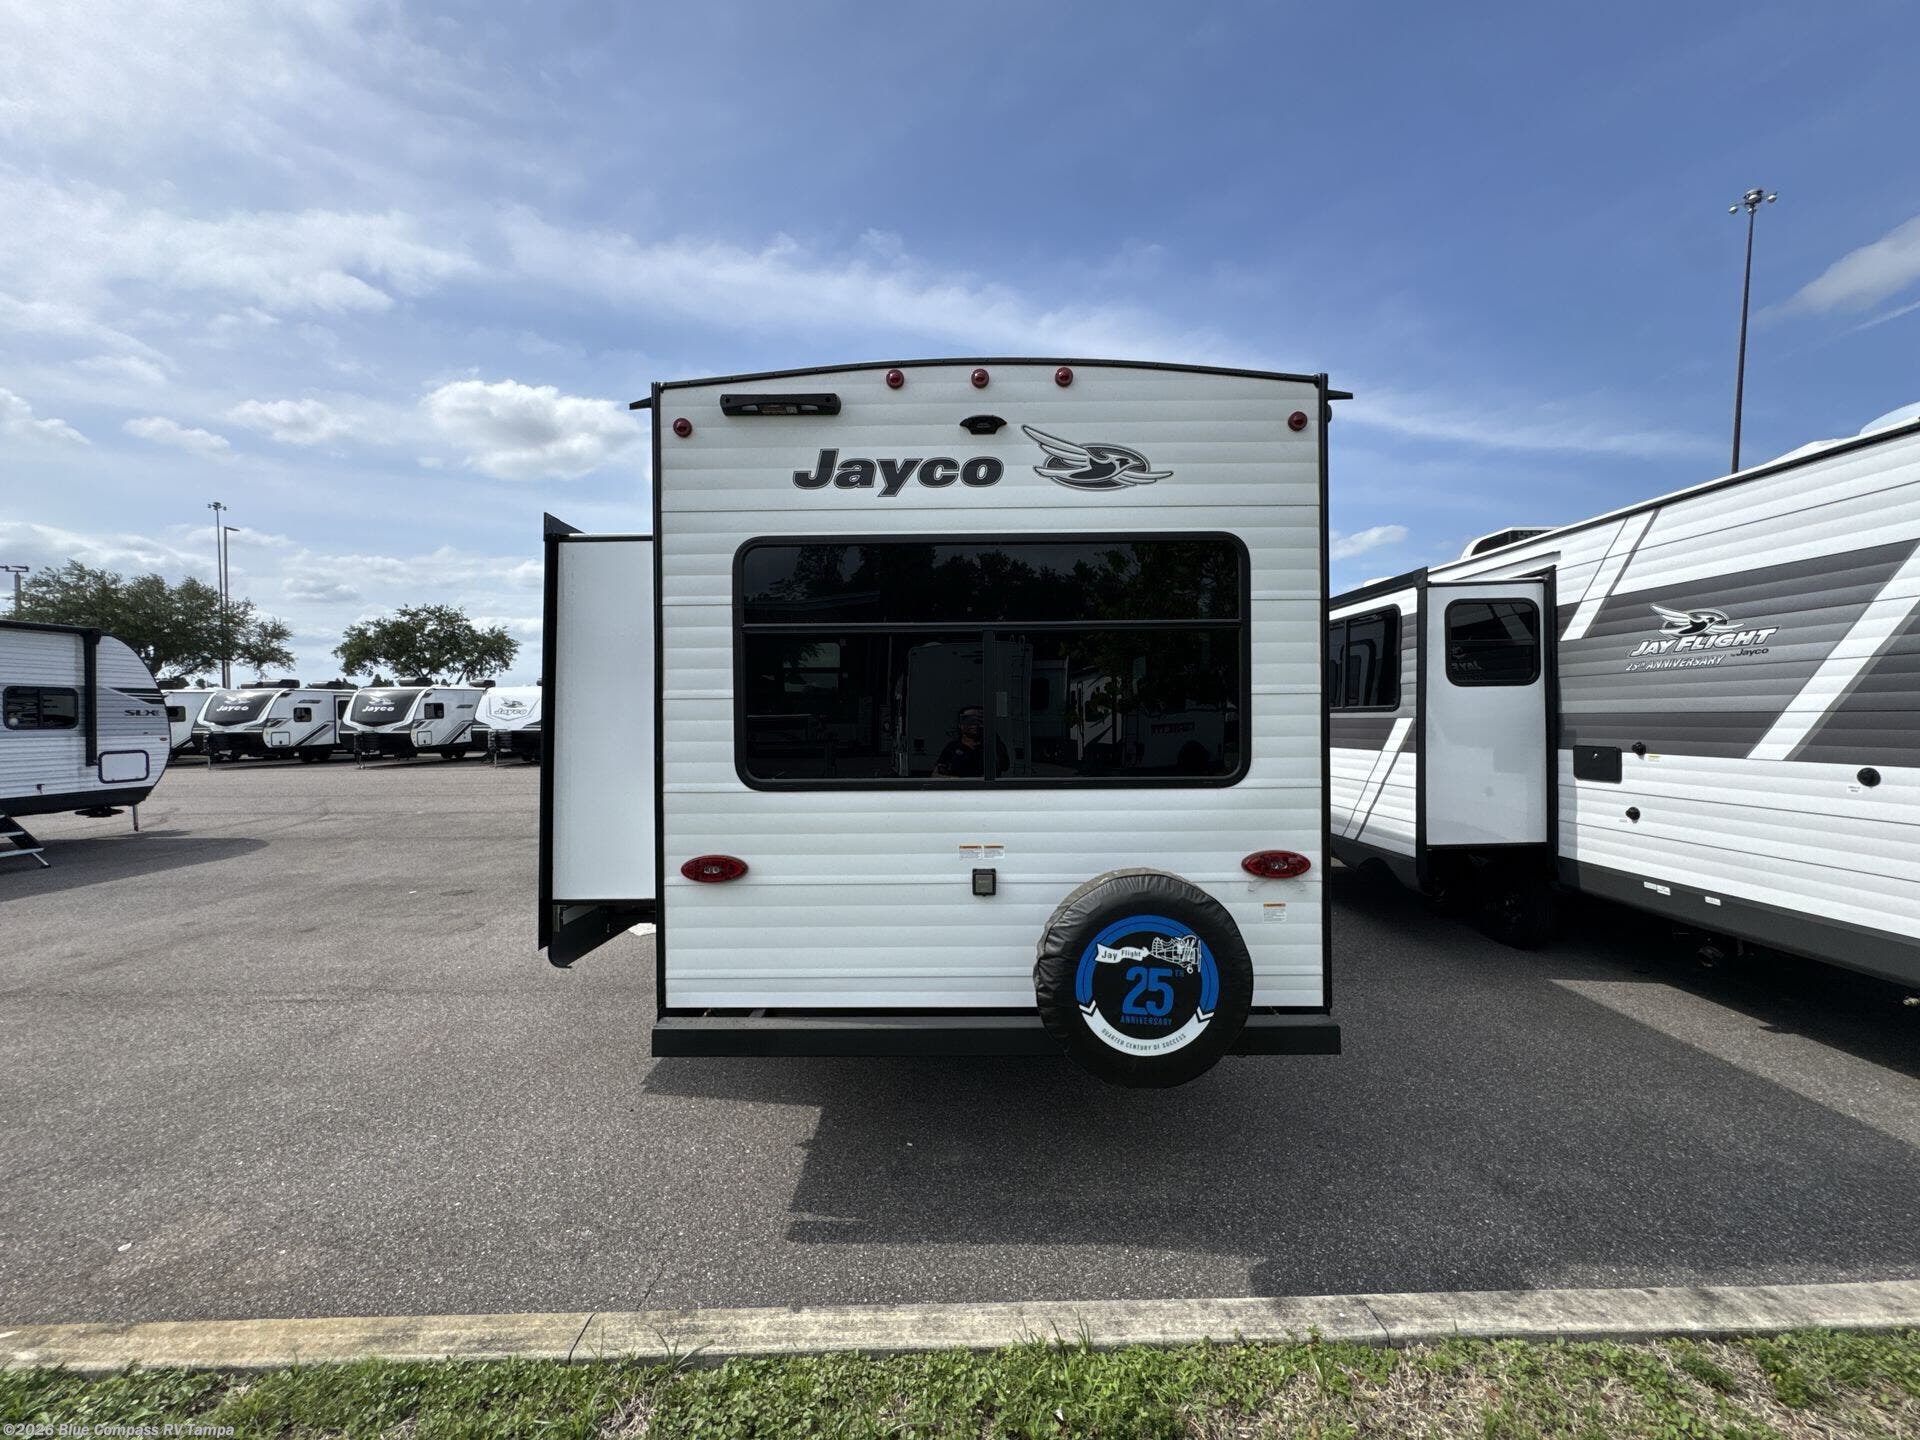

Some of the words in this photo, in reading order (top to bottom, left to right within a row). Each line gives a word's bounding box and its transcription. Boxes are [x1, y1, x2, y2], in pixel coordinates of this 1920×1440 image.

[792, 448, 1005, 497] Jayco
[1630, 639, 1676, 657] JAY
[1675, 627, 1779, 652] FLIGHT
[1736, 648, 1770, 656] Jayco
[1646, 655, 1726, 670] ANNIVERSARY
[1101, 951, 1118, 961] Jay
[1122, 950, 1142, 958] Flight
[1126, 1042, 1152, 1050] CENTURY
